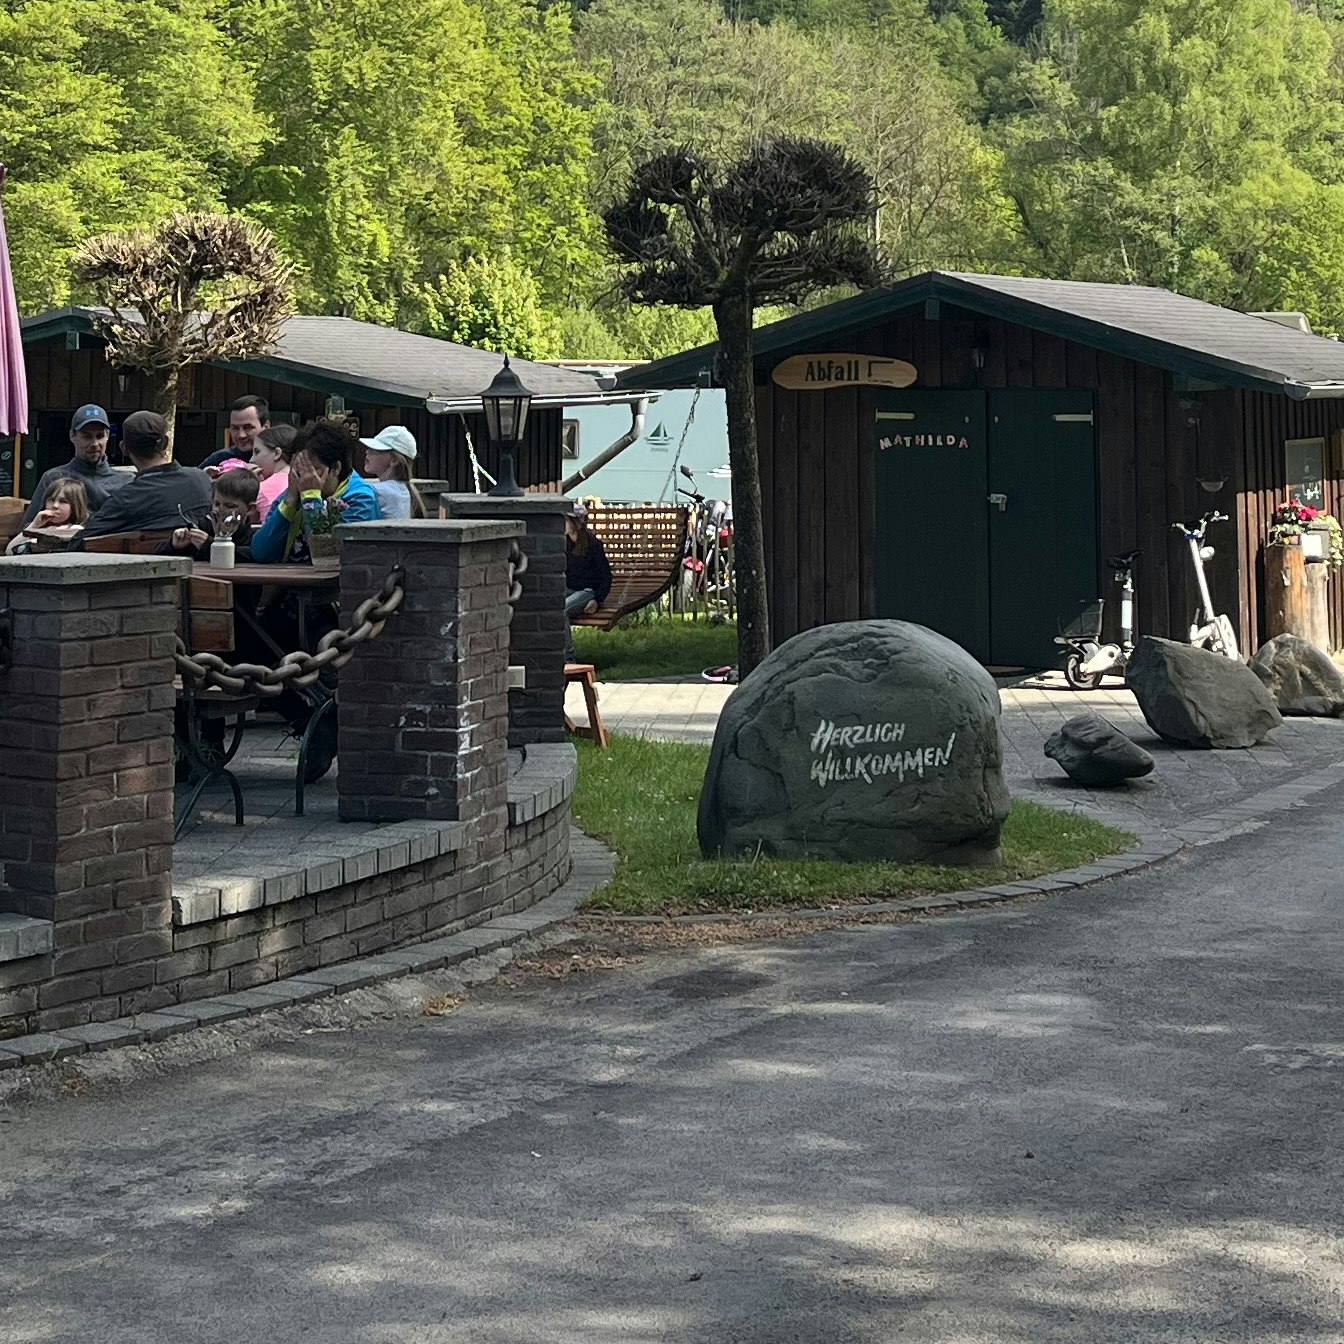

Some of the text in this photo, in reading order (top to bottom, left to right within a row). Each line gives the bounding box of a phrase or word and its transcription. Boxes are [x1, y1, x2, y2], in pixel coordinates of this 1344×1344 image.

[805, 360, 859, 381] Abfall
[879, 434, 969, 450] MATHILDA
[810, 719, 906, 754] HERZLICH
[810, 732, 956, 788] WILLKOMMEN
